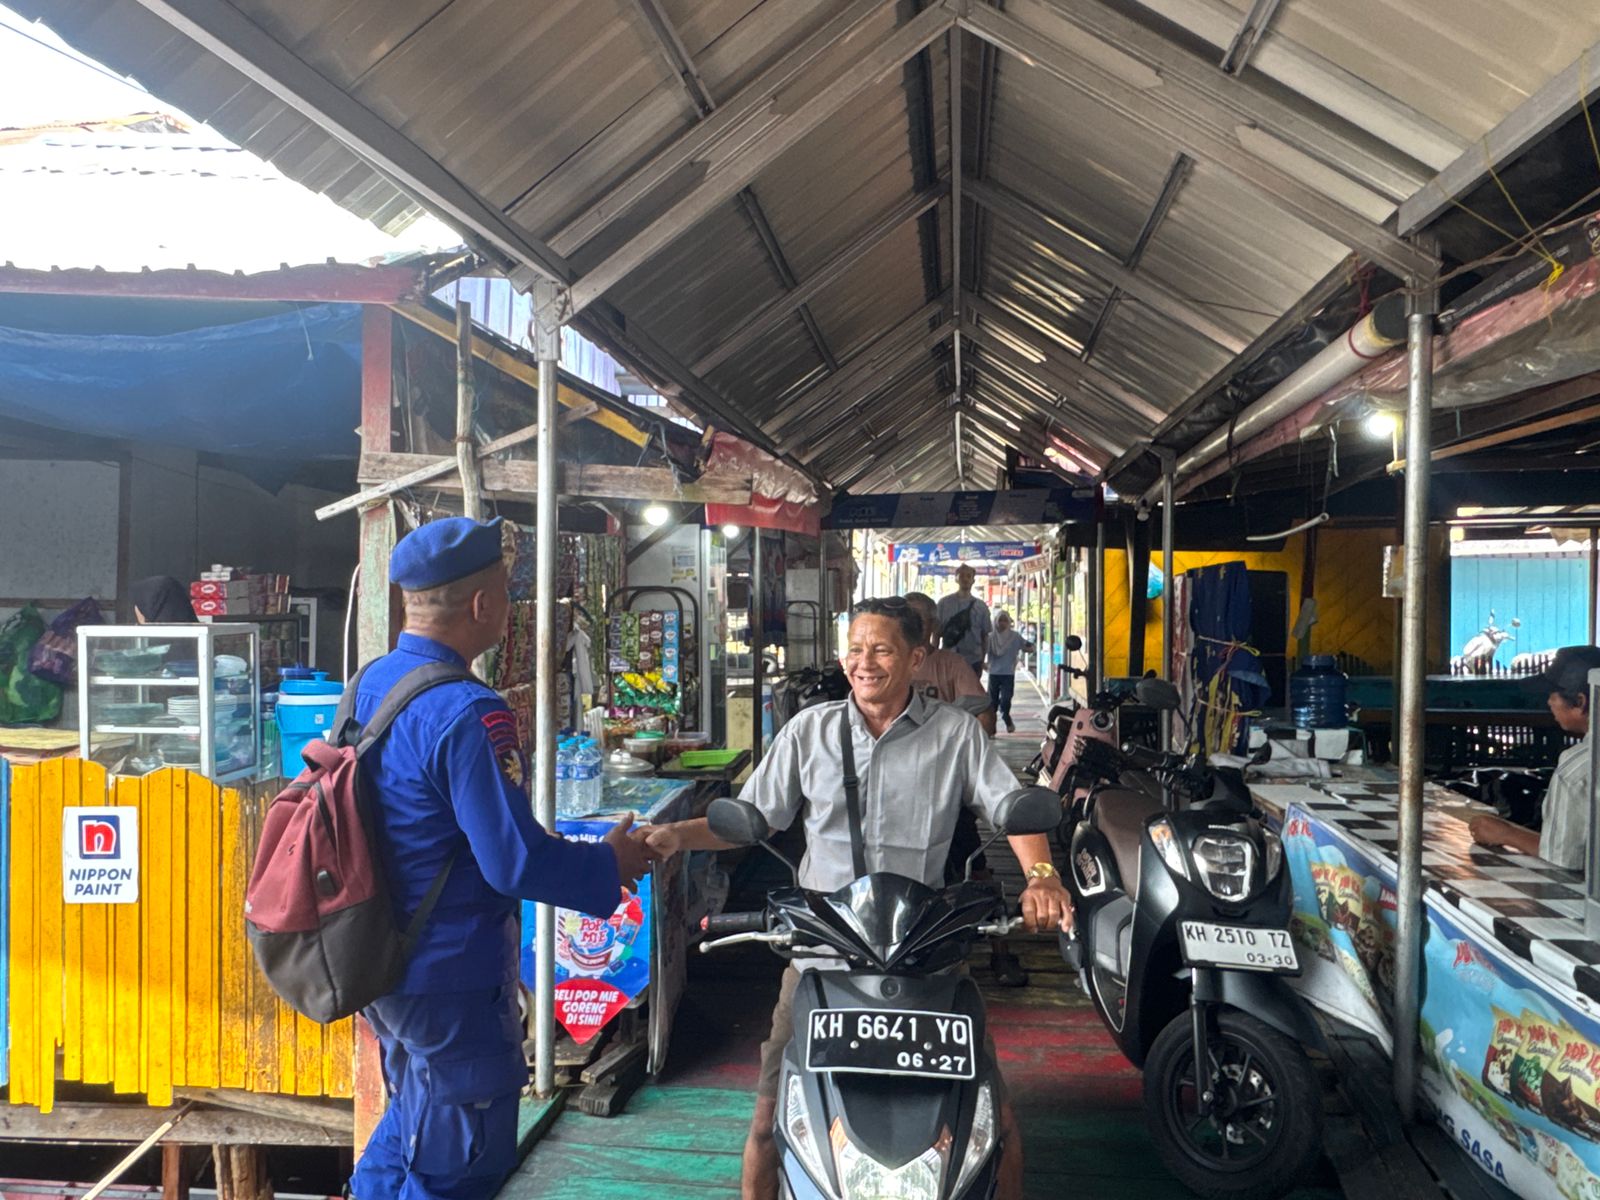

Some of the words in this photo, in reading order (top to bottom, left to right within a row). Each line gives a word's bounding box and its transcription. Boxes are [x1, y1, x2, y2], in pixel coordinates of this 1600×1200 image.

[69, 868, 132, 881] NIPPON
[74, 883, 123, 896] PAINT
[580, 918, 604, 931] POP
[581, 930, 608, 943] MIE
[1185, 925, 1207, 942] KH
[1214, 928, 1256, 946] 2510
[1267, 932, 1290, 948] TZ
[574, 990, 599, 1002] POP
[599, 991, 619, 1003] MIE
[562, 1001, 607, 1014] GORENG
[565, 1013, 577, 1025] DI
[577, 1014, 603, 1026] SINI!
[813, 1013, 843, 1039] KH
[857, 1014, 919, 1042] 6641
[936, 1018, 968, 1046] YQ
[1461, 1128, 1509, 1186] SASA
